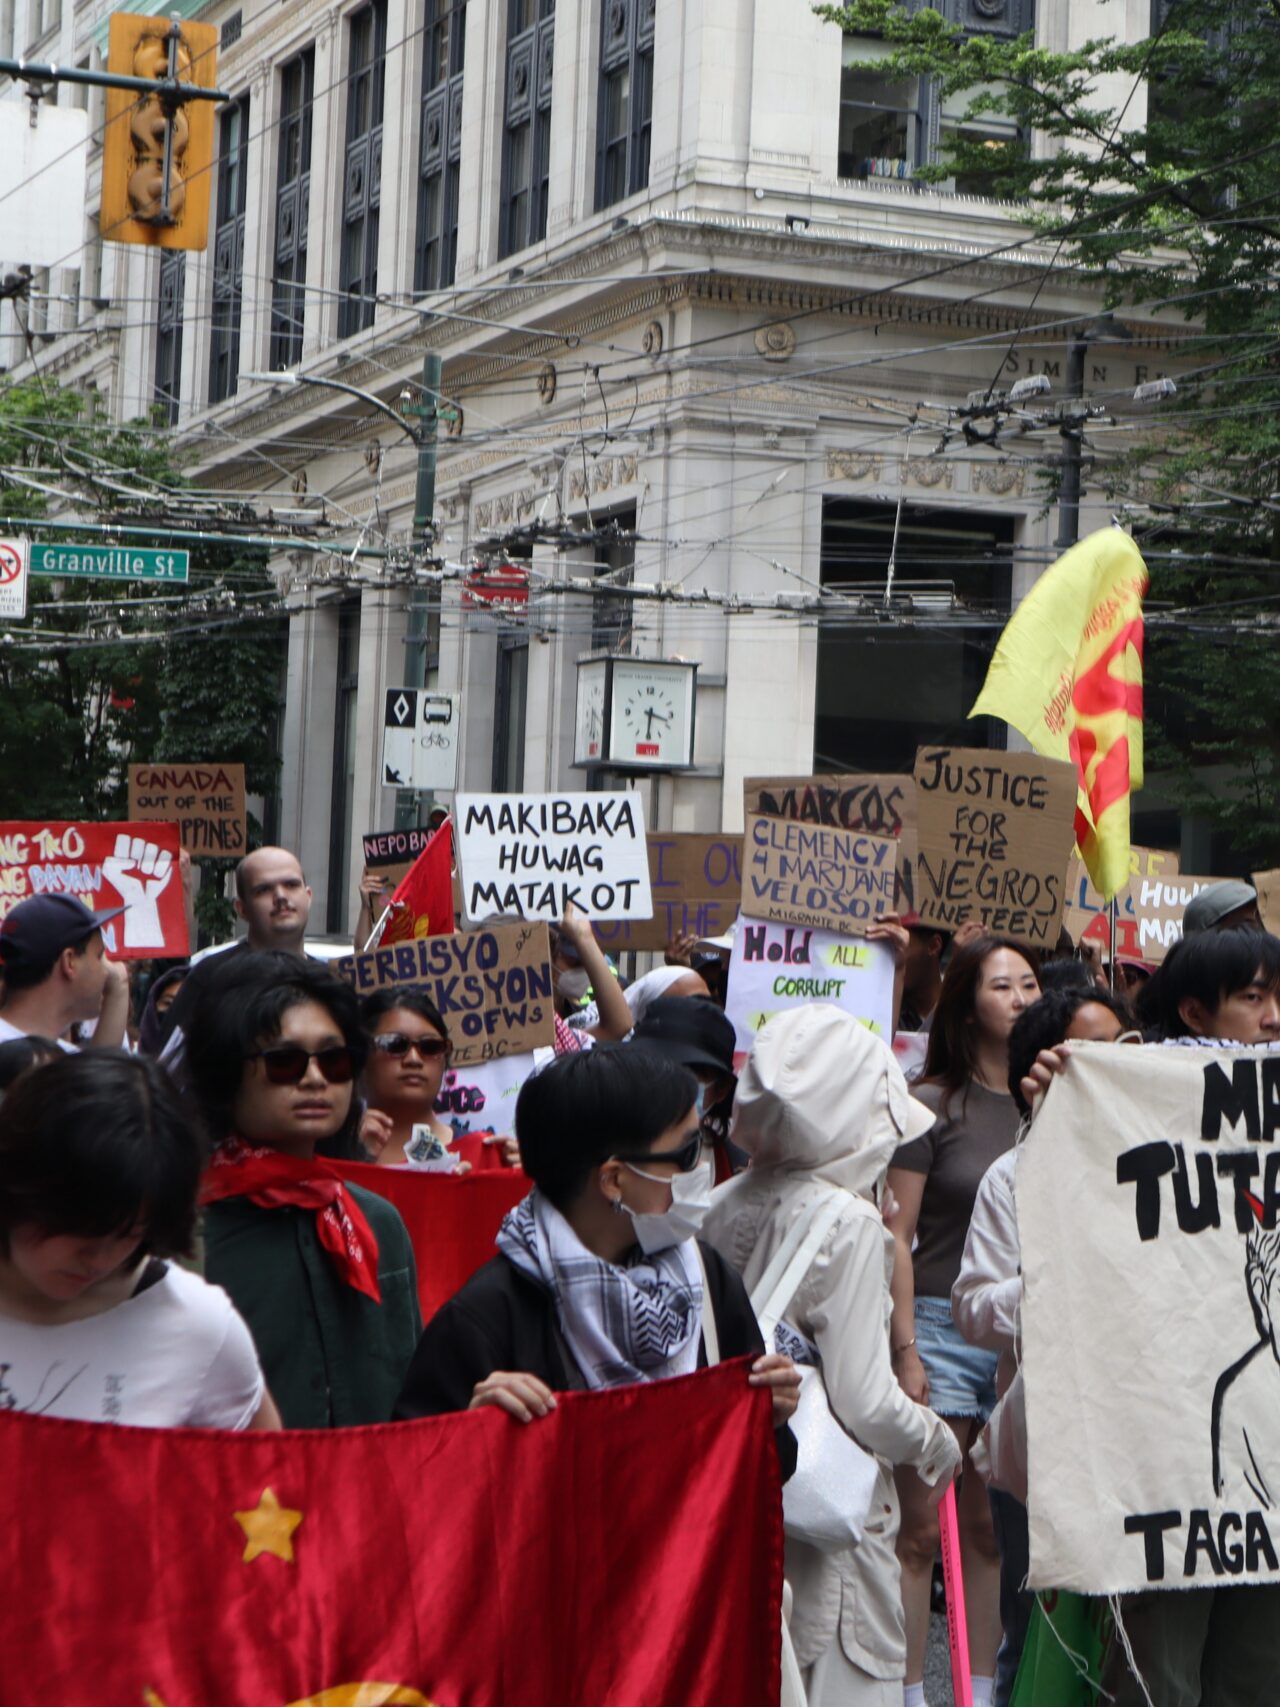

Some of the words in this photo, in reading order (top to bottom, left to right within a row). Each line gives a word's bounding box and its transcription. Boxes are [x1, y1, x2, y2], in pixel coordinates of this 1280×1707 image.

[1006, 350, 1107, 382] SIMN
[42, 549, 145, 576] Granville
[154, 555, 175, 577] St
[136, 768, 235, 793] CANADA
[920, 750, 1049, 809] JUSTICE
[137, 795, 169, 809] OUT
[174, 795, 196, 809] OF
[202, 795, 235, 812] THE
[464, 799, 636, 839] MAKIBAKA
[758, 784, 904, 834] MARCOS
[753, 818, 890, 867] CLEMENCY
[955, 805, 1008, 843] FOR
[364, 833, 407, 858] NEPO
[499, 841, 604, 876] HUWAG
[949, 832, 1008, 861] THE
[752, 850, 768, 875] 4
[779, 854, 847, 893] MARY
[845, 865, 896, 900] JANE
[917, 851, 1059, 917] NEGROS
[470, 879, 641, 917] MATAKOT
[768, 907, 834, 927] MIGRANTE
[656, 900, 721, 943] THE
[338, 932, 499, 990] SERBISYO
[743, 923, 814, 966] Hold
[832, 944, 864, 968] ALL
[773, 975, 847, 999] CORRUPT
[461, 1003, 543, 1037] OFWs
[1124, 1509, 1280, 1582] TAGA
